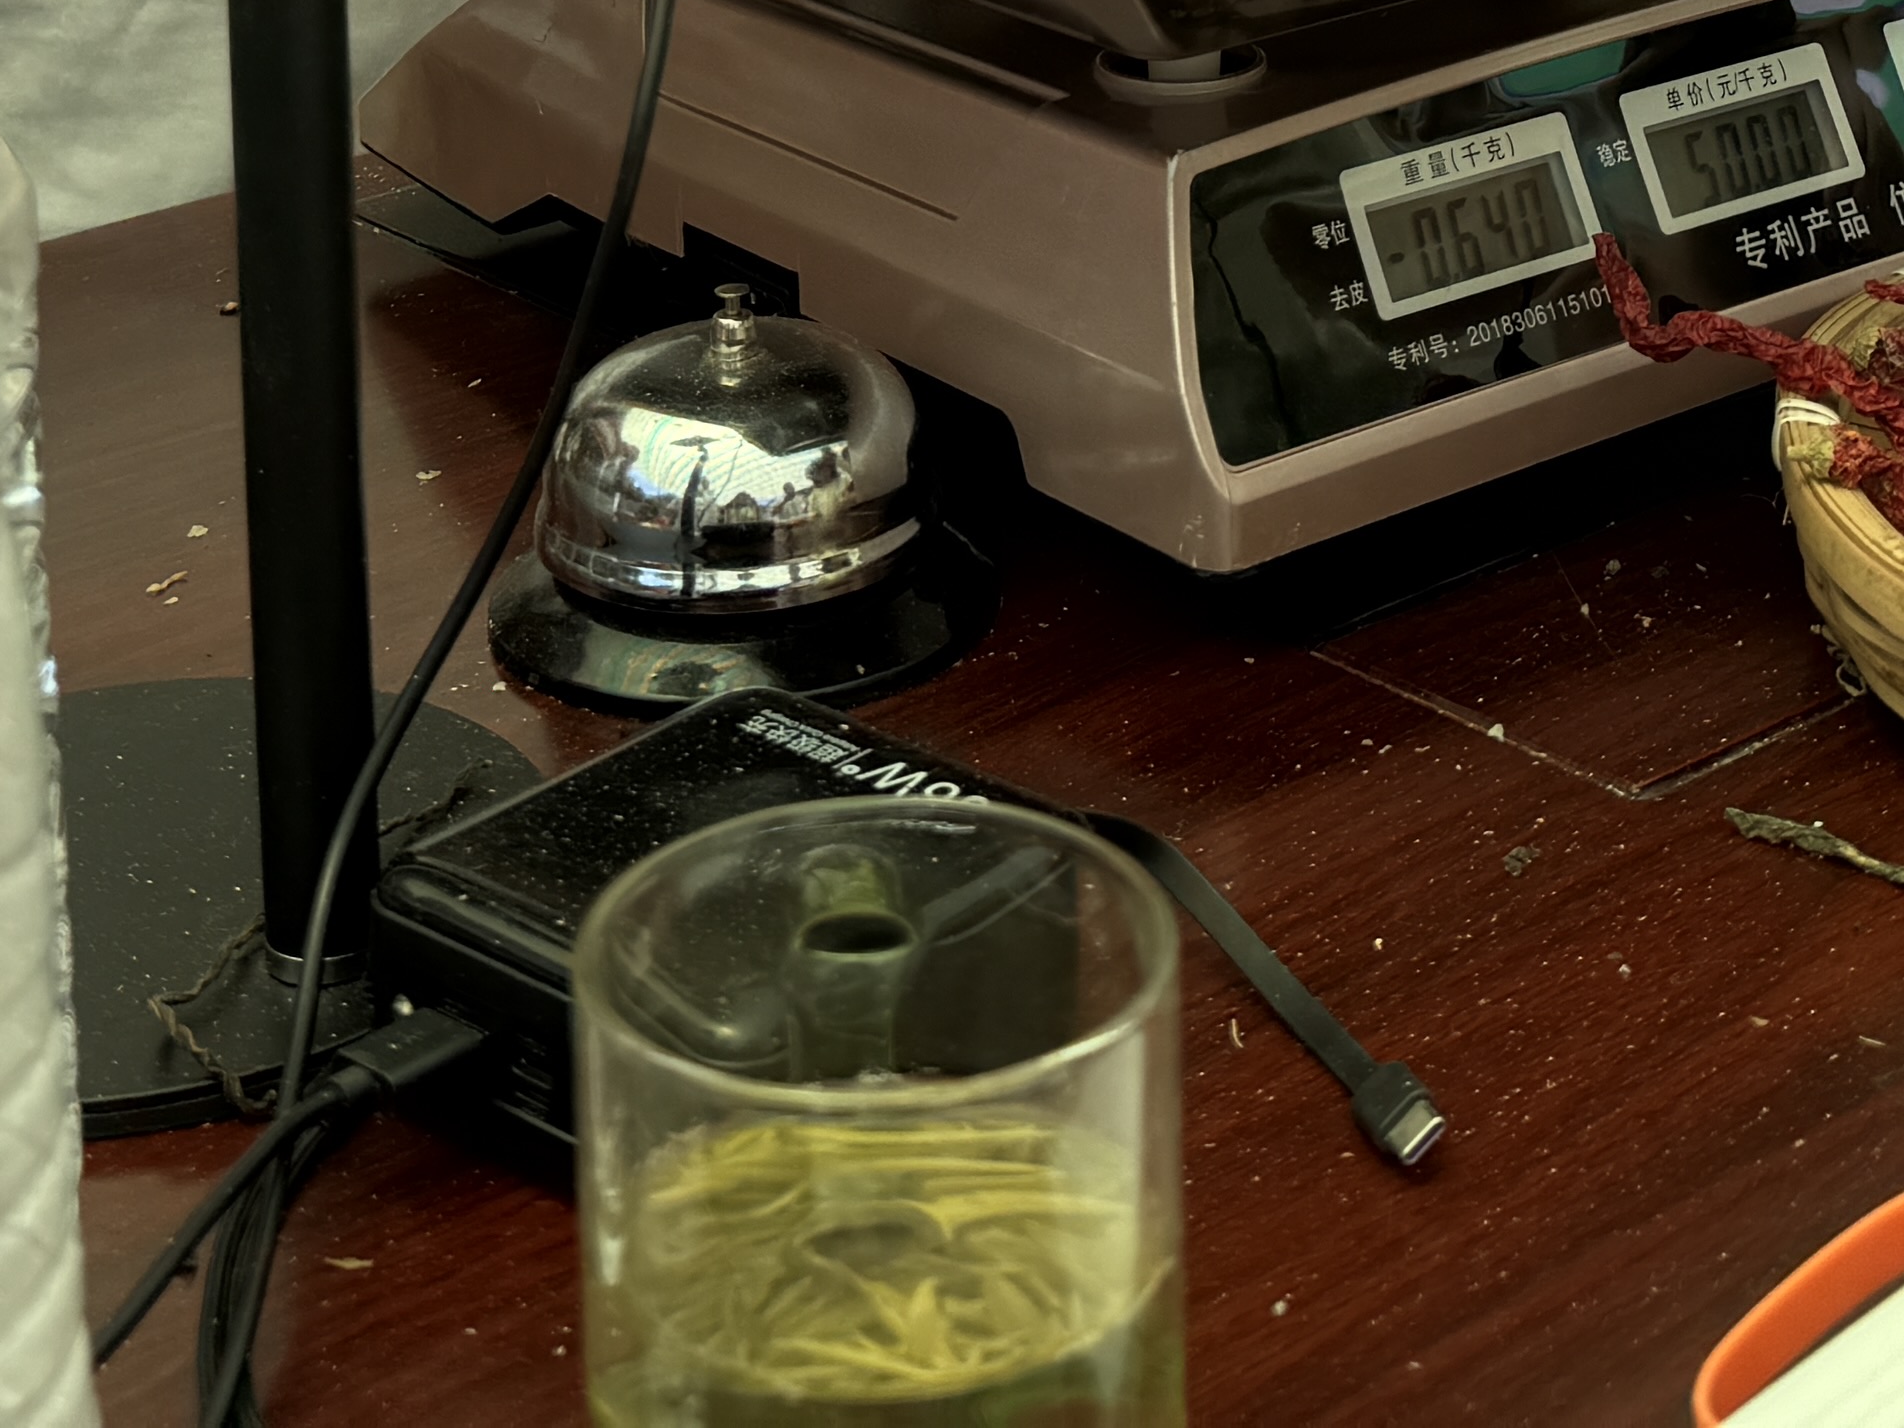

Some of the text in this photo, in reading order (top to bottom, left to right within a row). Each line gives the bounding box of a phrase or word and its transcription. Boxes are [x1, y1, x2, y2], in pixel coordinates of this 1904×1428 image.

[1665, 58, 1787, 112] 单价(元/千克)
[1399, 131, 1516, 186] 重量(千克)
[1596, 138, 1633, 168] 稳定
[1311, 220, 1351, 250] 零位
[1735, 197, 1871, 271] 专利产品
[1329, 280, 1369, 312] 去皮
